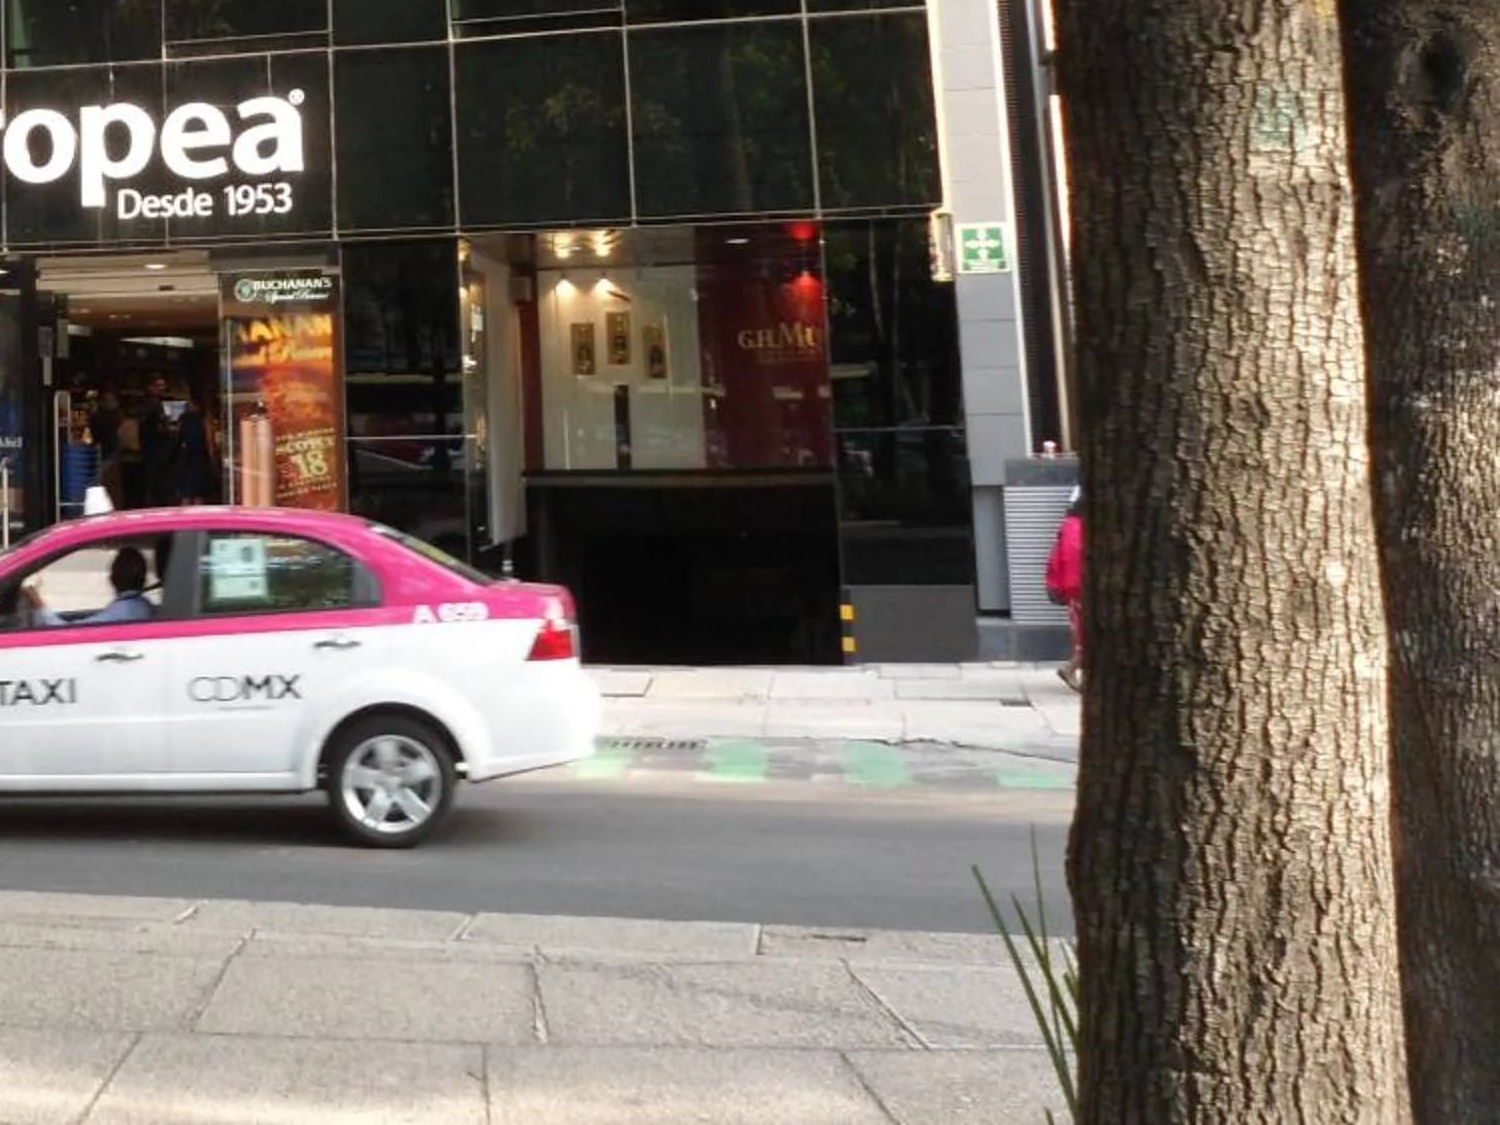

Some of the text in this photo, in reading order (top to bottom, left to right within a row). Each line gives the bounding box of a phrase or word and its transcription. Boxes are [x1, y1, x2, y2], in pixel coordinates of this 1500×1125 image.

[117, 181, 293, 220] Desde 1953
[290, 450, 328, 478] 18
[185, 673, 303, 703] CDMX
